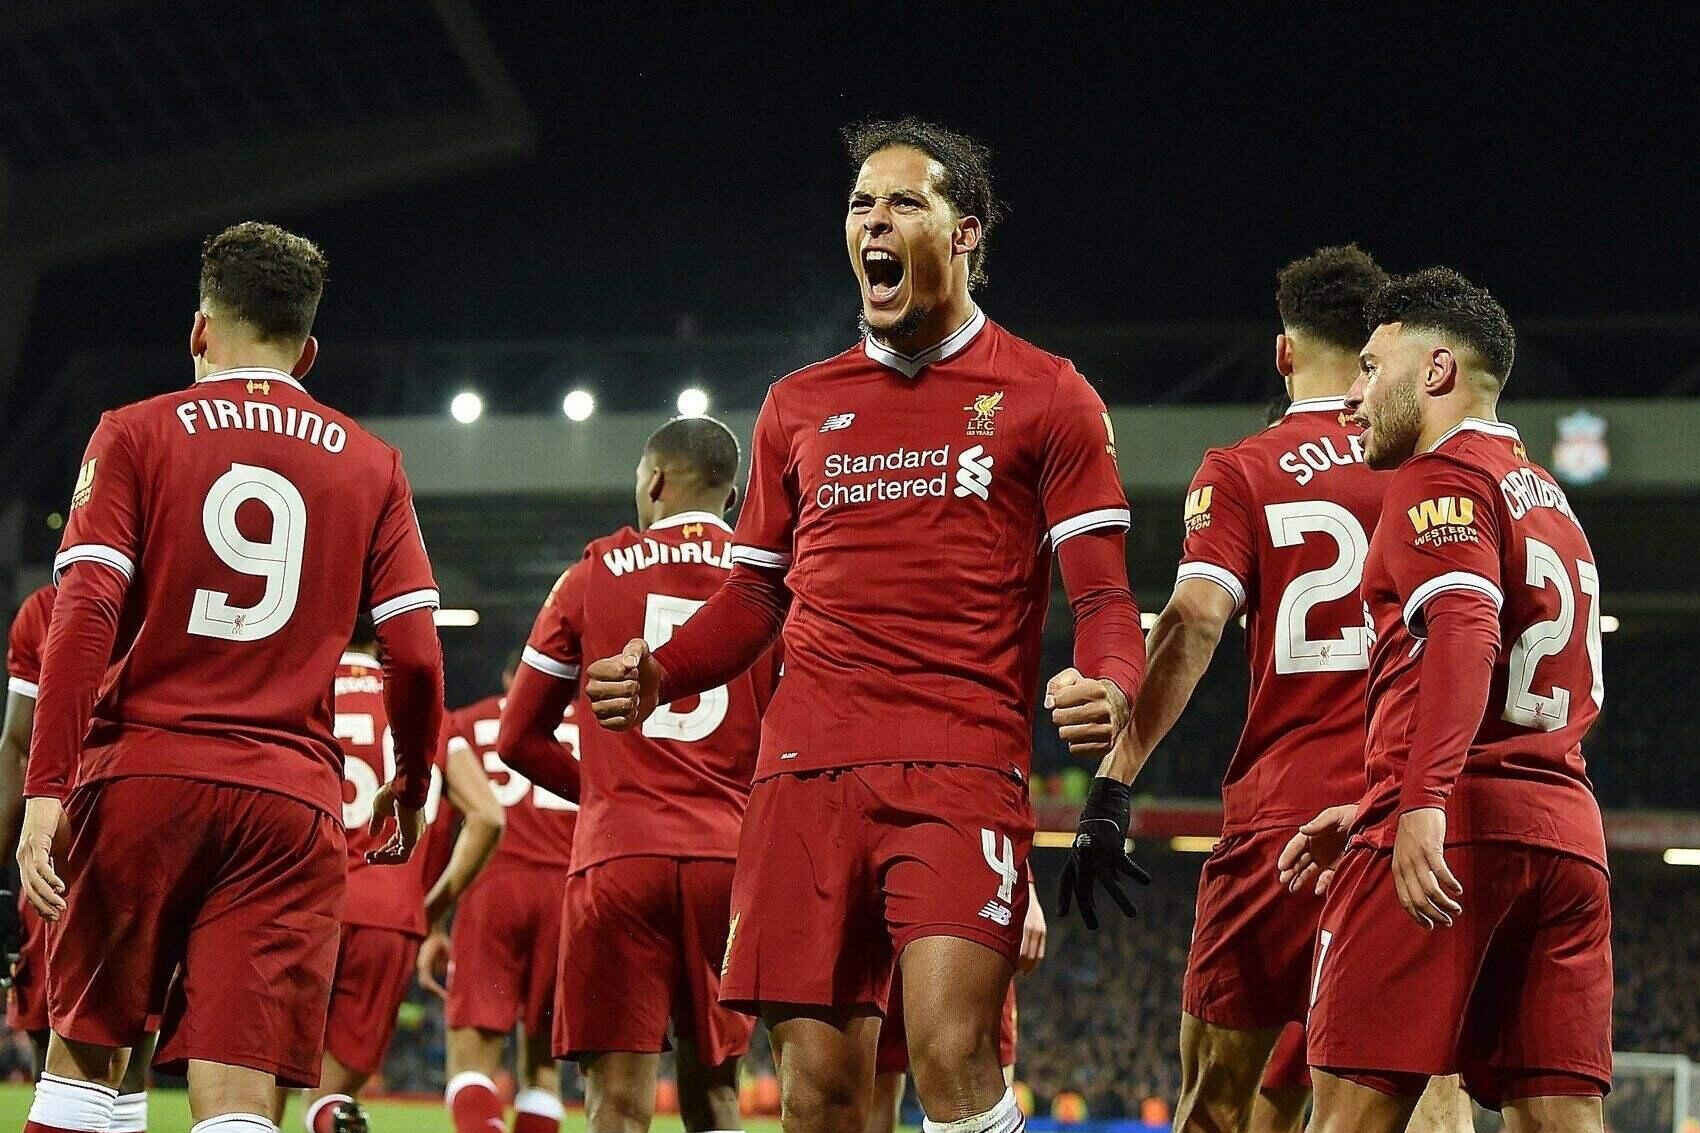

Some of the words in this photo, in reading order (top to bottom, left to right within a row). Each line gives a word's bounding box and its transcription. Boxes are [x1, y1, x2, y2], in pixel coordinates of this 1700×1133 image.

[176, 400, 348, 454] FIRMINO
[824, 444, 950, 478] Standard
[816, 472, 947, 509] Chartered
[1407, 496, 1474, 534] WU
[186, 462, 307, 642] 9
[1414, 526, 1478, 546] WESTERN
[1432, 533, 1480, 547] UNION
[643, 593, 729, 742] 5
[981, 828, 1018, 904] 4
